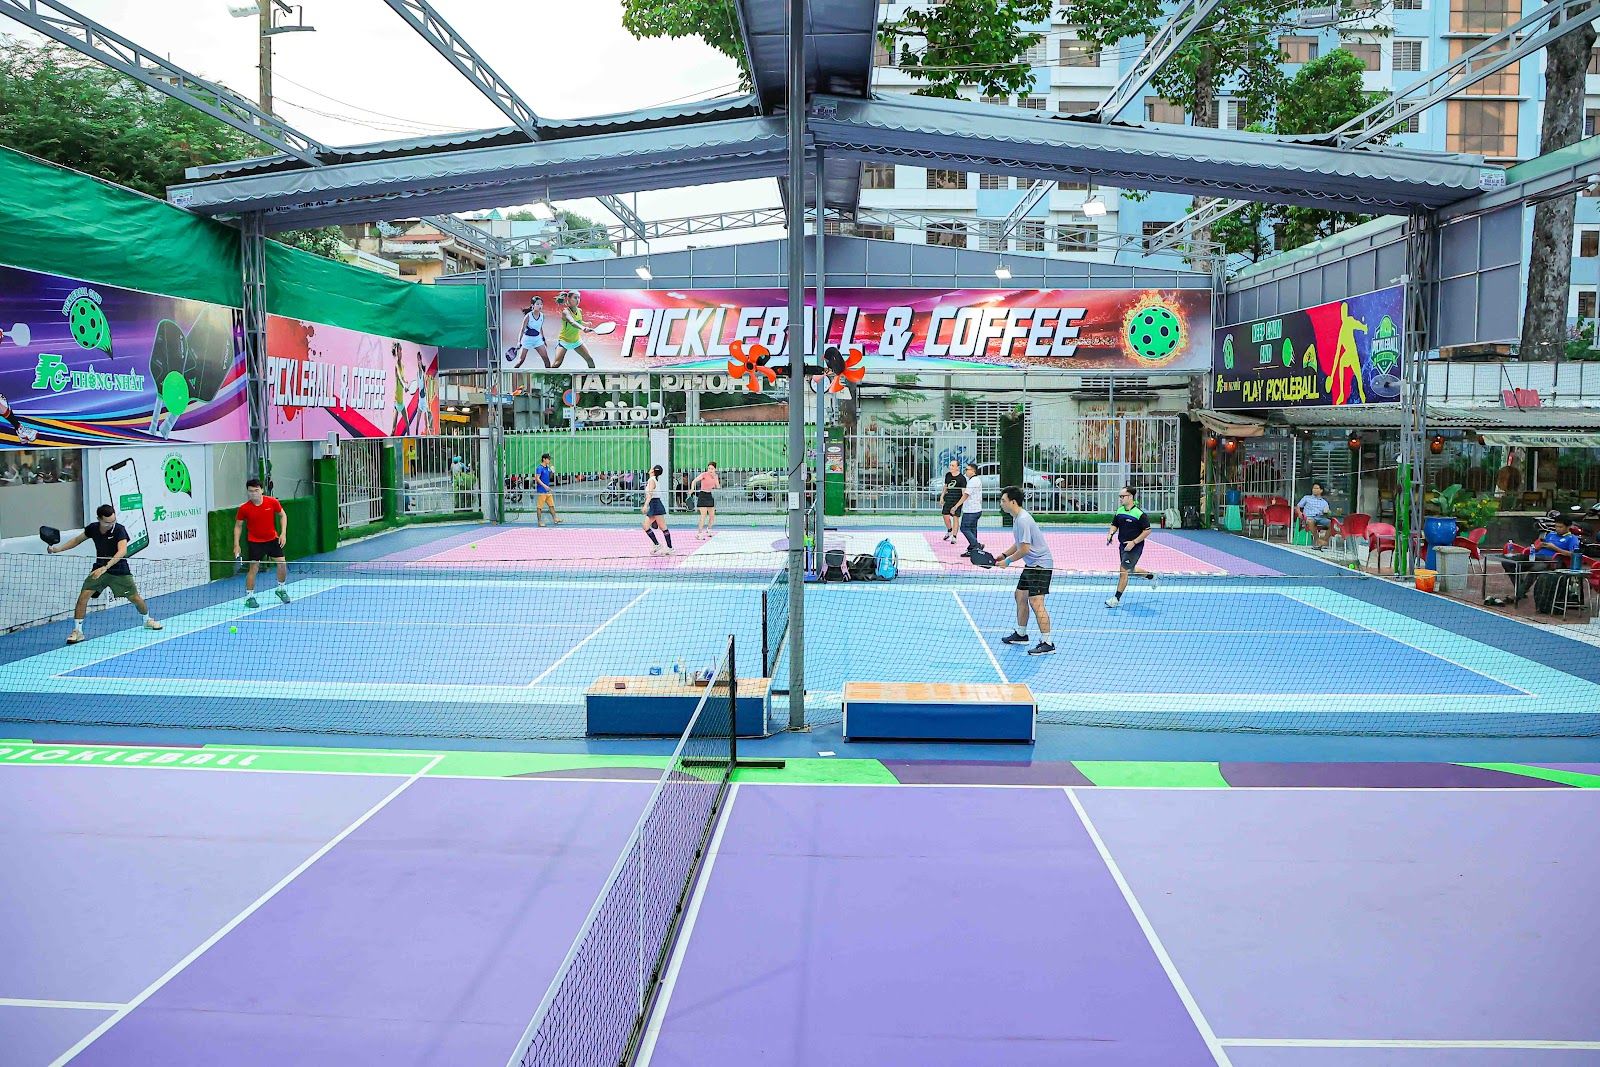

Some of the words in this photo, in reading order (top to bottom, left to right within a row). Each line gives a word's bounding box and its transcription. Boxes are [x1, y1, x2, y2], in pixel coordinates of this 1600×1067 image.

[878, 306, 915, 361] &
[924, 306, 1088, 357] COFFEE
[267, 356, 337, 408] PICKLEBALL
[340, 365, 349, 411] &
[350, 367, 386, 410] COFFEE
[1243, 379, 1264, 403] PLAY
[1266, 375, 1320, 401] PICKLEBALL
[183, 528, 198, 540] NGAY
